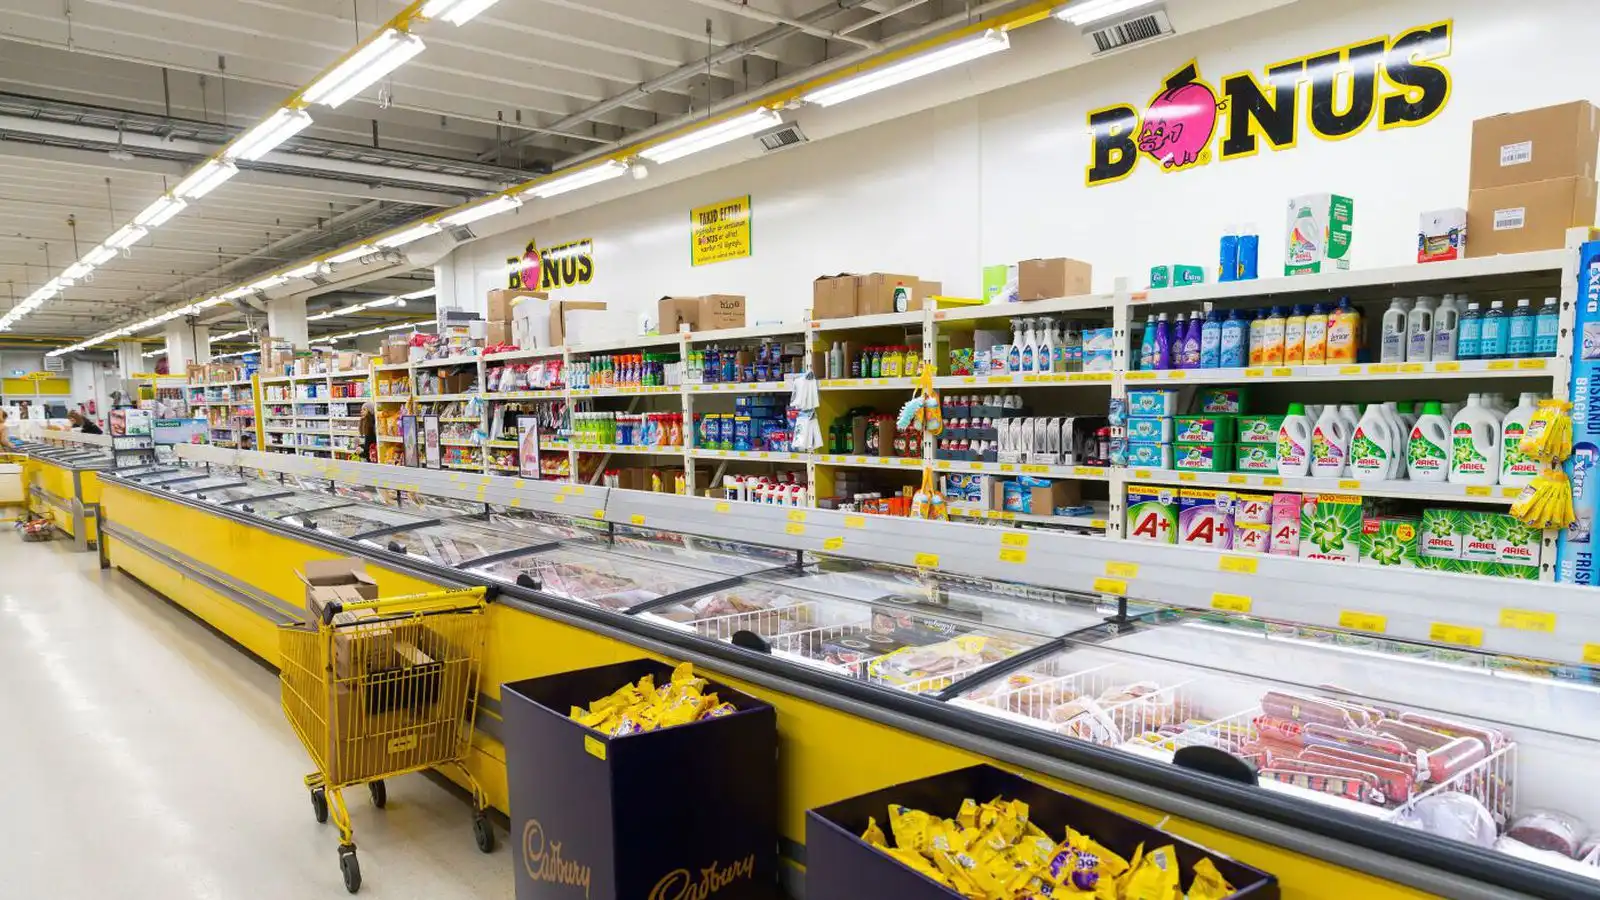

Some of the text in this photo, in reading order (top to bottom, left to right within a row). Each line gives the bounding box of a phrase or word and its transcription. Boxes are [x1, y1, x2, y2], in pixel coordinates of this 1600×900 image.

[1132, 512, 1170, 538] A+
[1186, 516, 1228, 544] A+
[1428, 538, 1454, 546] ARIEL
[1468, 542, 1496, 550] ARIEL
[1502, 547, 1532, 556] ARIEL
[522, 819, 591, 899] Cadbury
[648, 853, 754, 900] Cadbury
